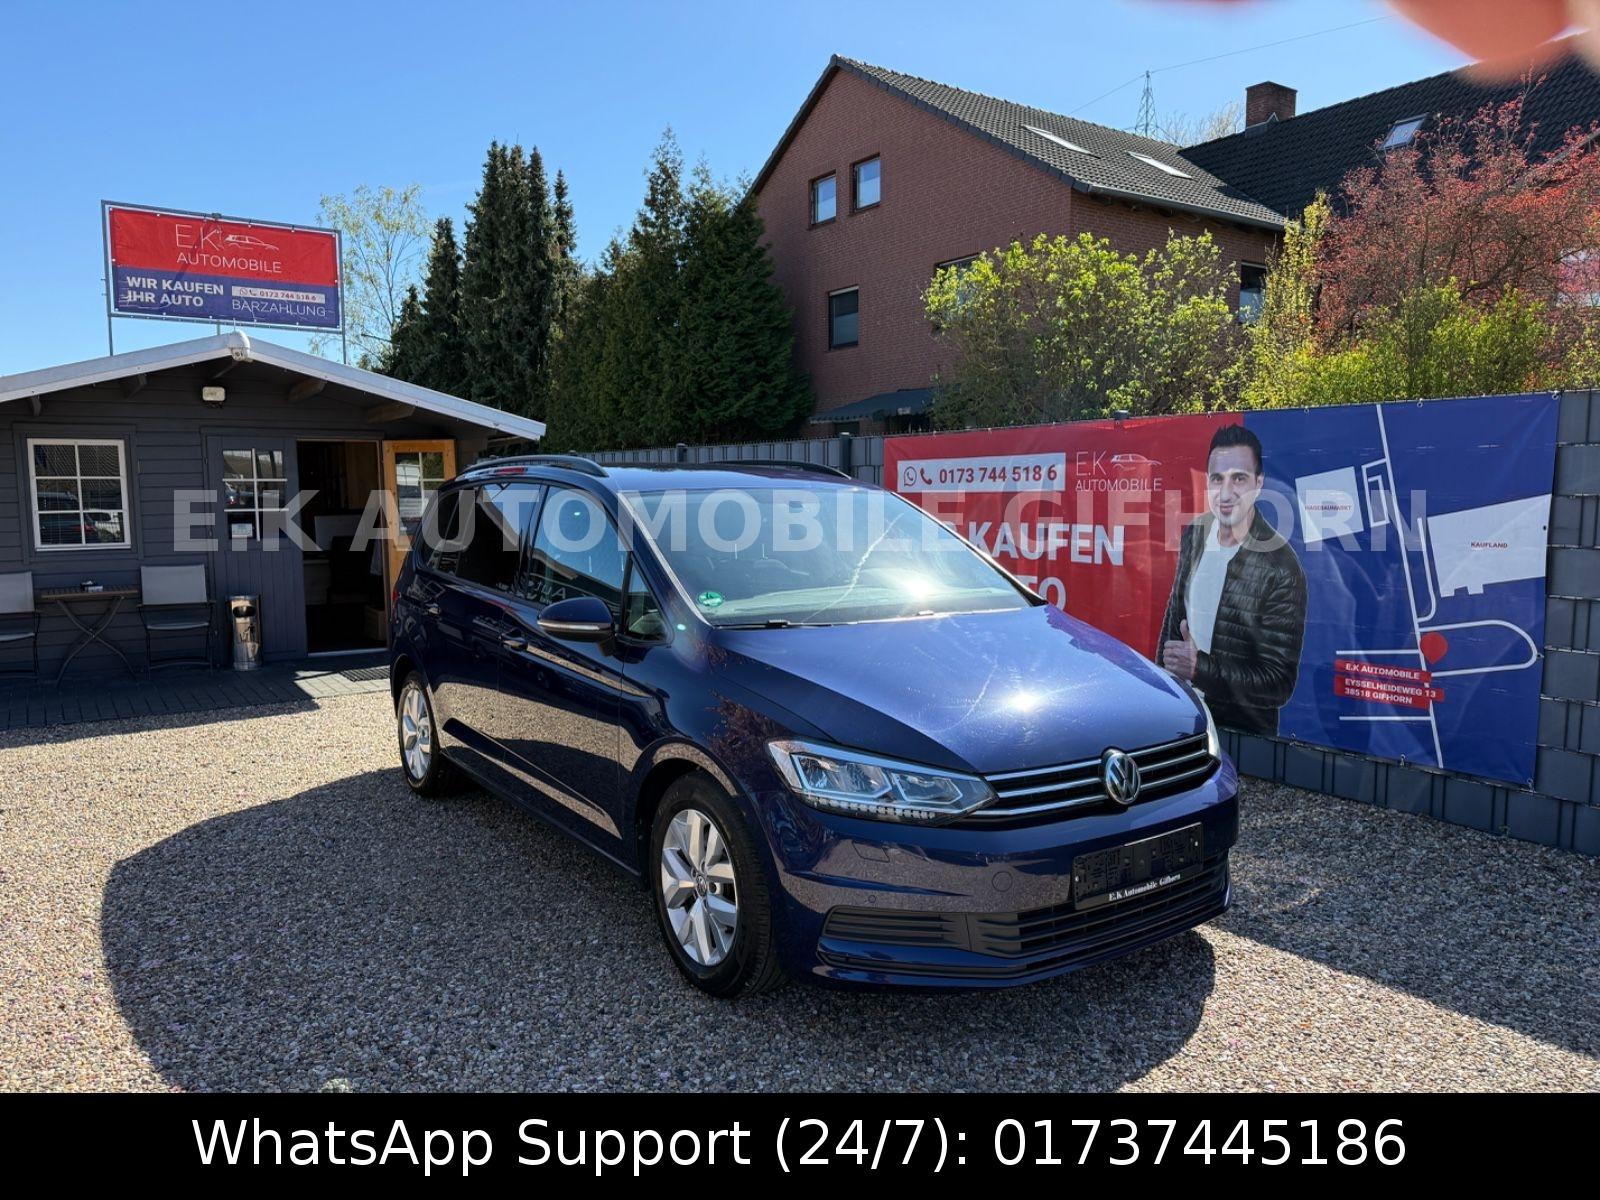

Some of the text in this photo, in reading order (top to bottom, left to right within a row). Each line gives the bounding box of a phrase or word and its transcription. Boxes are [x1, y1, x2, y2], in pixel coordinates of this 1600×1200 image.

[175, 223, 220, 251] E.K
[176, 252, 282, 273] AUTOMOBILE
[126, 276, 224, 295] WIR KAUFEN
[127, 290, 204, 307] IHR AUTO
[232, 299, 326, 317] BARZAHLUNG
[1076, 451, 1107, 476] E.K
[939, 464, 1058, 484] 0173 744 518 6
[1075, 478, 1162, 492] AUTOMOBILE
[968, 521, 1125, 566] KAUFEN
[1471, 541, 1508, 549] KAUFLAND
[1345, 663, 1420, 679] E.K AUTOMOBILE
[1345, 678, 1436, 698] EYSSELHEIDEWEG 13
[1372, 691, 1413, 704] GIFHORN
